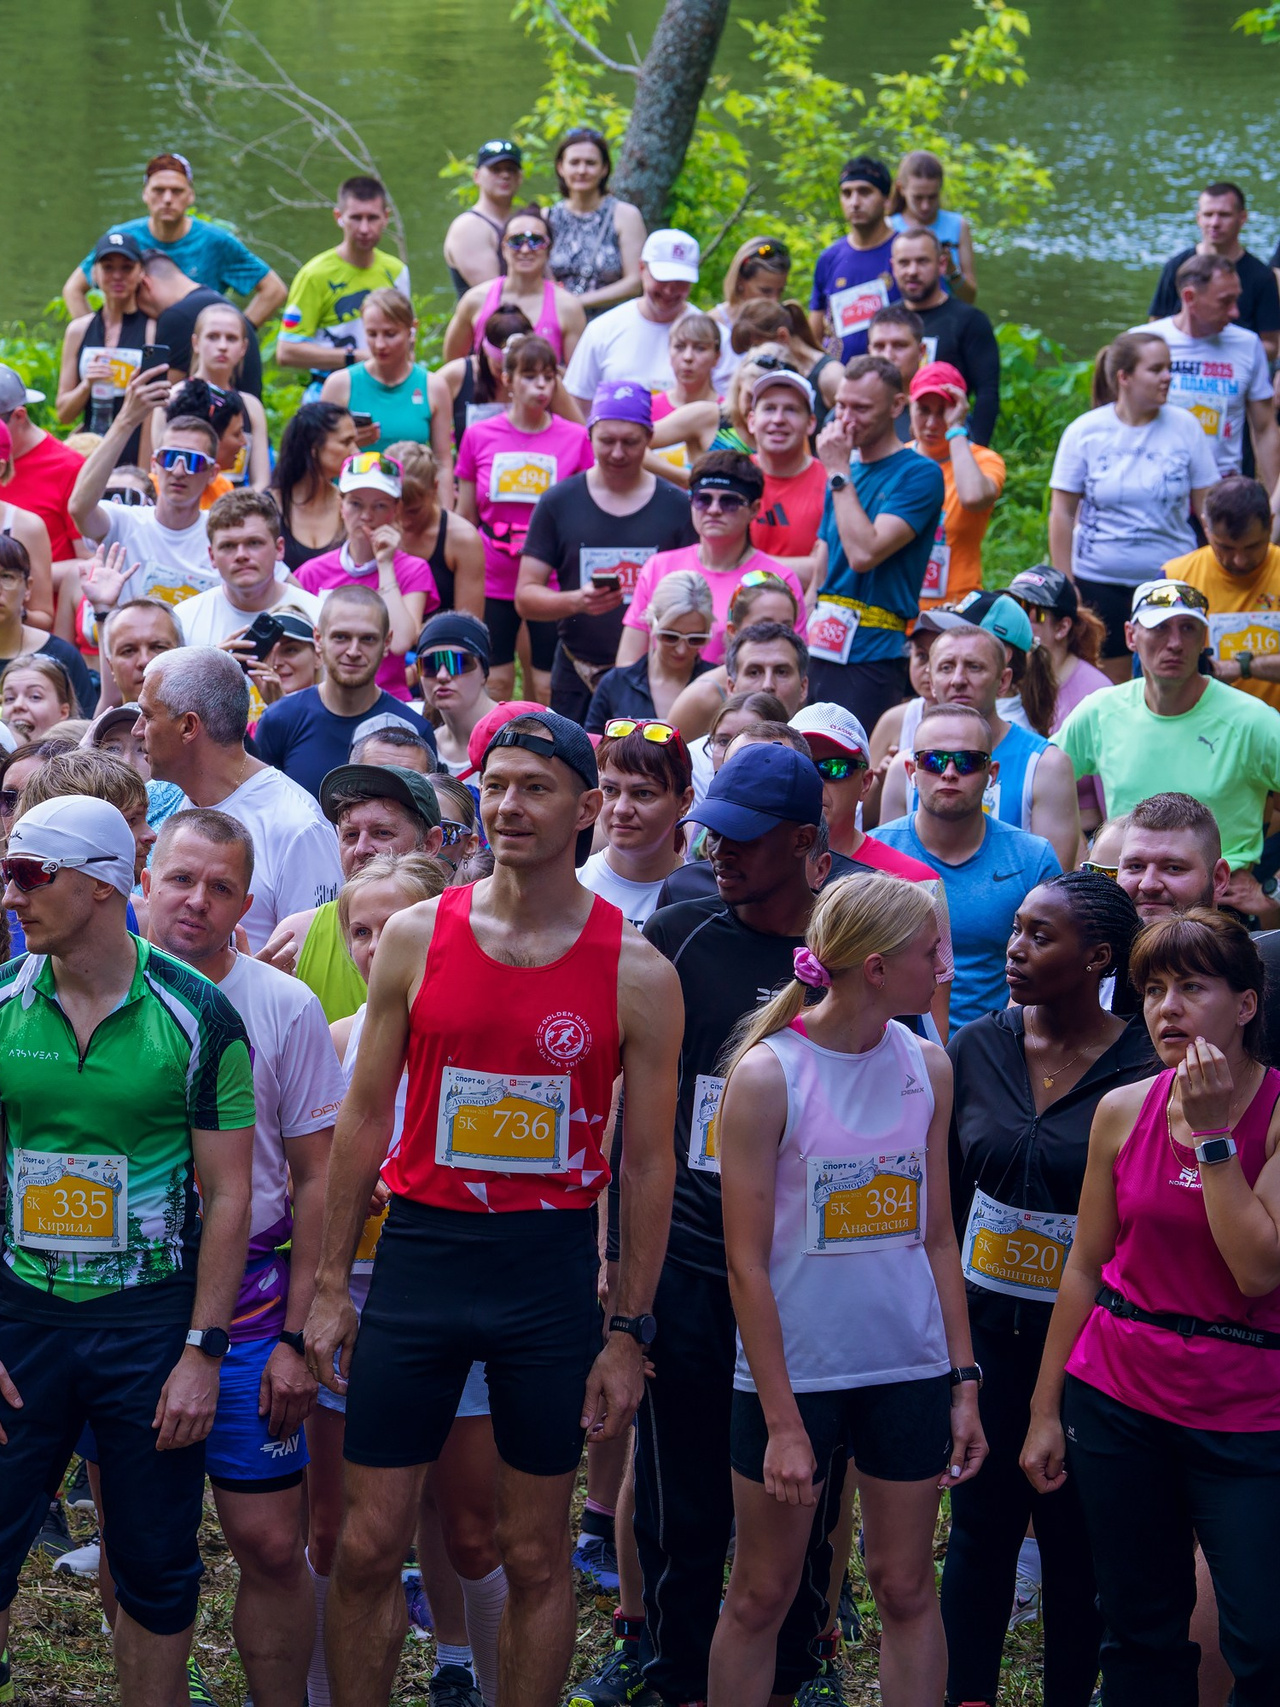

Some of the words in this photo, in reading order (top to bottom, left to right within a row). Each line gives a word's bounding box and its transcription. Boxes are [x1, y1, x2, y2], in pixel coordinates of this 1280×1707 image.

[1242, 632, 1277, 650] 416
[542, 1011, 573, 1025] GOLDEN
[575, 1015, 590, 1032] RING
[539, 1048, 561, 1067] ULTRA
[901, 1087, 925, 1096] DEMIX
[493, 1109, 550, 1140] 736
[52, 1189, 107, 1219] 335
[865, 1184, 913, 1218] 384
[38, 1217, 93, 1236] Кирилл
[839, 1218, 909, 1235] Анастасия
[1003, 1239, 1059, 1272] 520
[978, 1256, 1054, 1288] Себаштиау
[1207, 1324, 1265, 1344] AONIJIE
[263, 1434, 299, 1459] RAY
